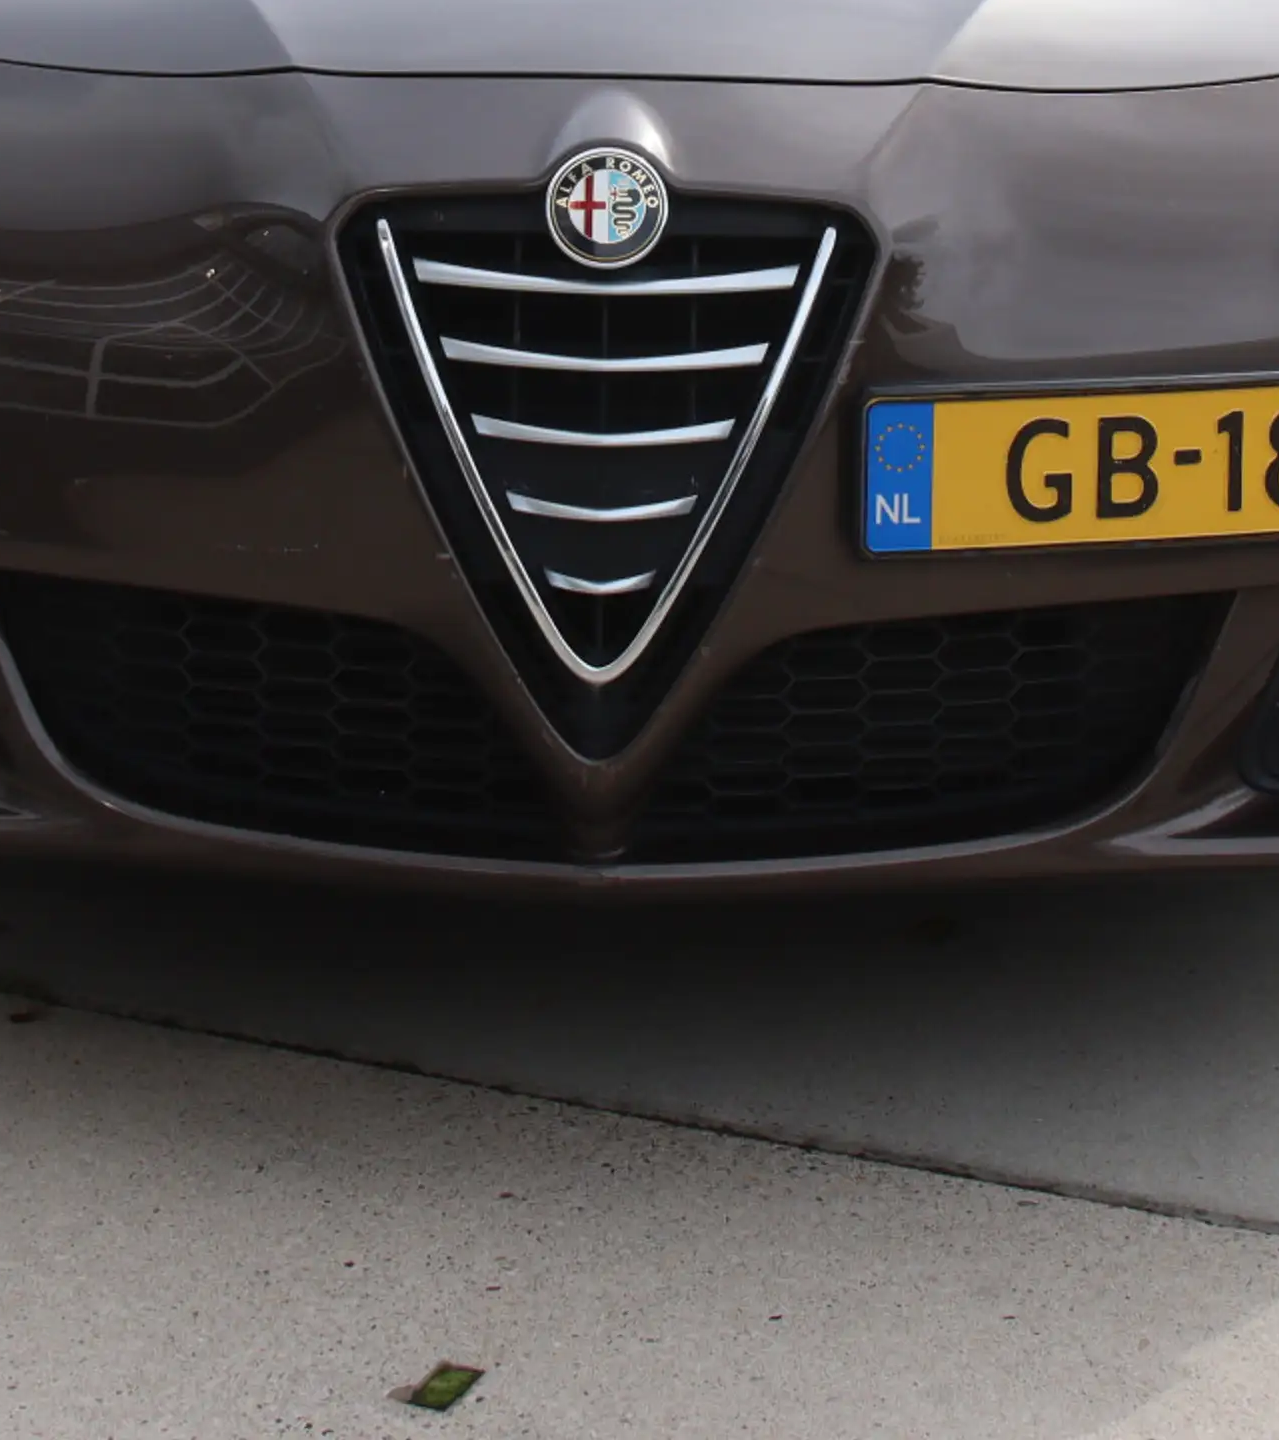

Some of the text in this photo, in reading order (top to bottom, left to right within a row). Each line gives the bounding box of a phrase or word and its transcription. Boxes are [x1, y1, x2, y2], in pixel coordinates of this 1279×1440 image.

[555, 156, 659, 208] ALFA ROMEO
[875, 491, 922, 525] NL
